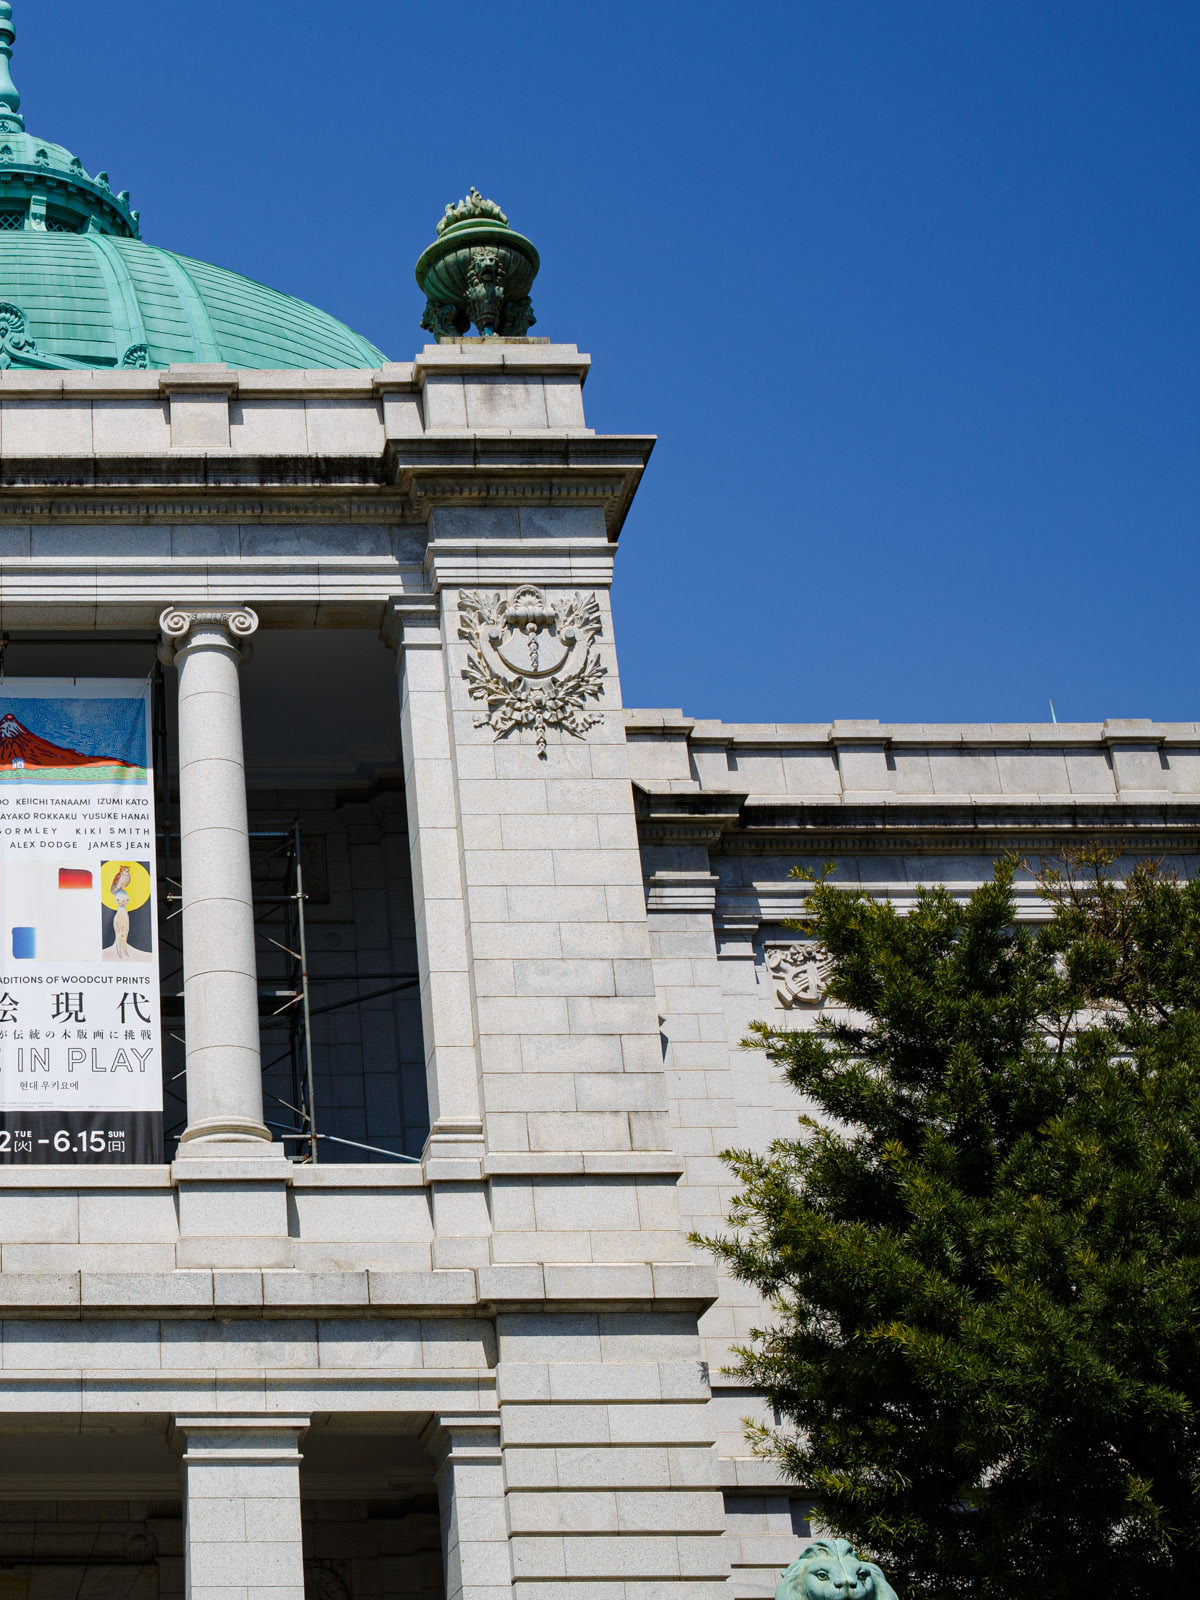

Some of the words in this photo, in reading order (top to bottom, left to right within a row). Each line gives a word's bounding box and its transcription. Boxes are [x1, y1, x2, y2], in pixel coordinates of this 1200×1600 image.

[88, 841, 122, 850] JAMES
[126, 842, 150, 850] JEAN
[18, 1048, 50, 1072] IN
[68, 1048, 154, 1072] PLAY
[20, 1080, 38, 1090] 현대
[41, 1080, 78, 1090] 우키요에
[54, 1130, 106, 1152] 6.15
